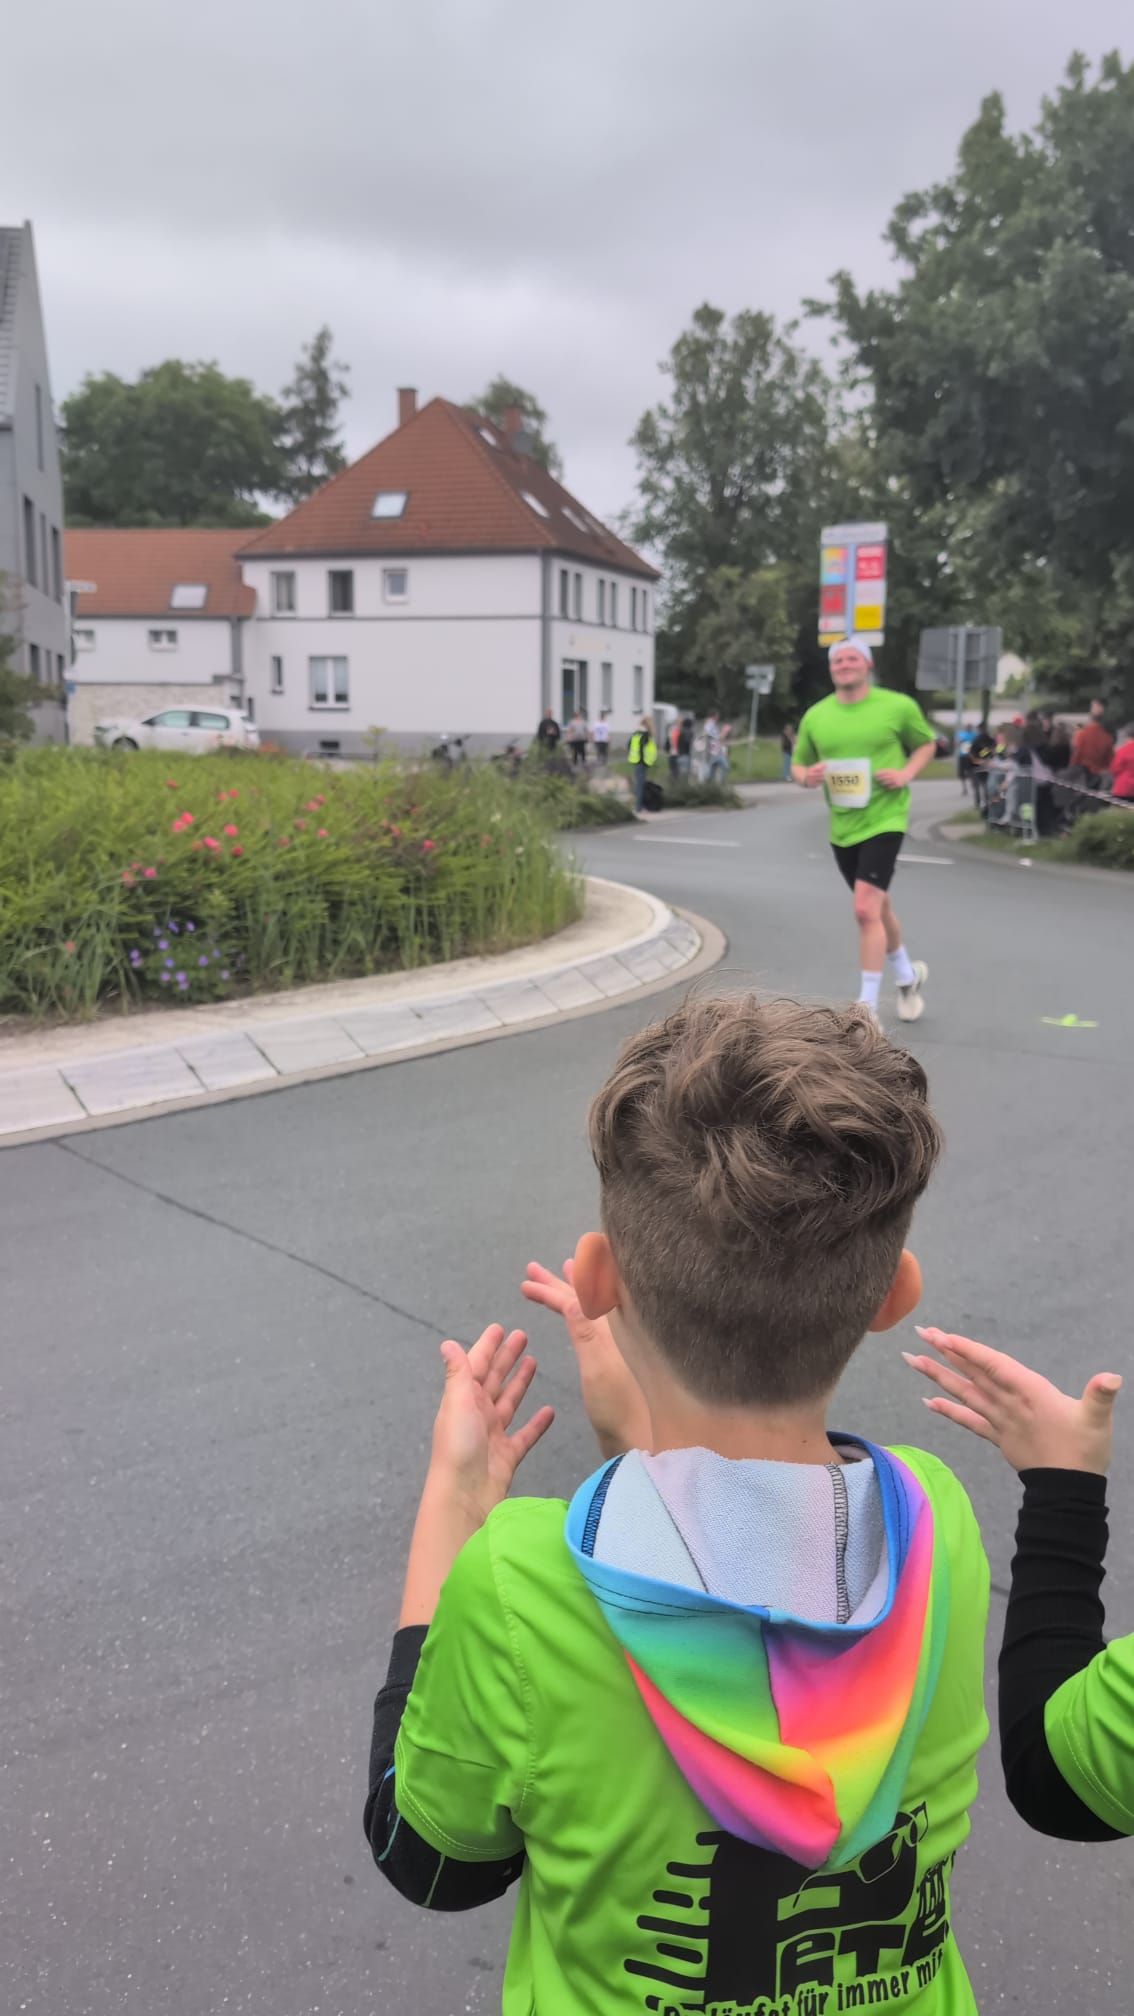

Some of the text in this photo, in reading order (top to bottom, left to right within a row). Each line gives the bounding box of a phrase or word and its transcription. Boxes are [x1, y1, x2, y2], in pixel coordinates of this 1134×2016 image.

[798, 1947, 943, 2016] für immer mit
